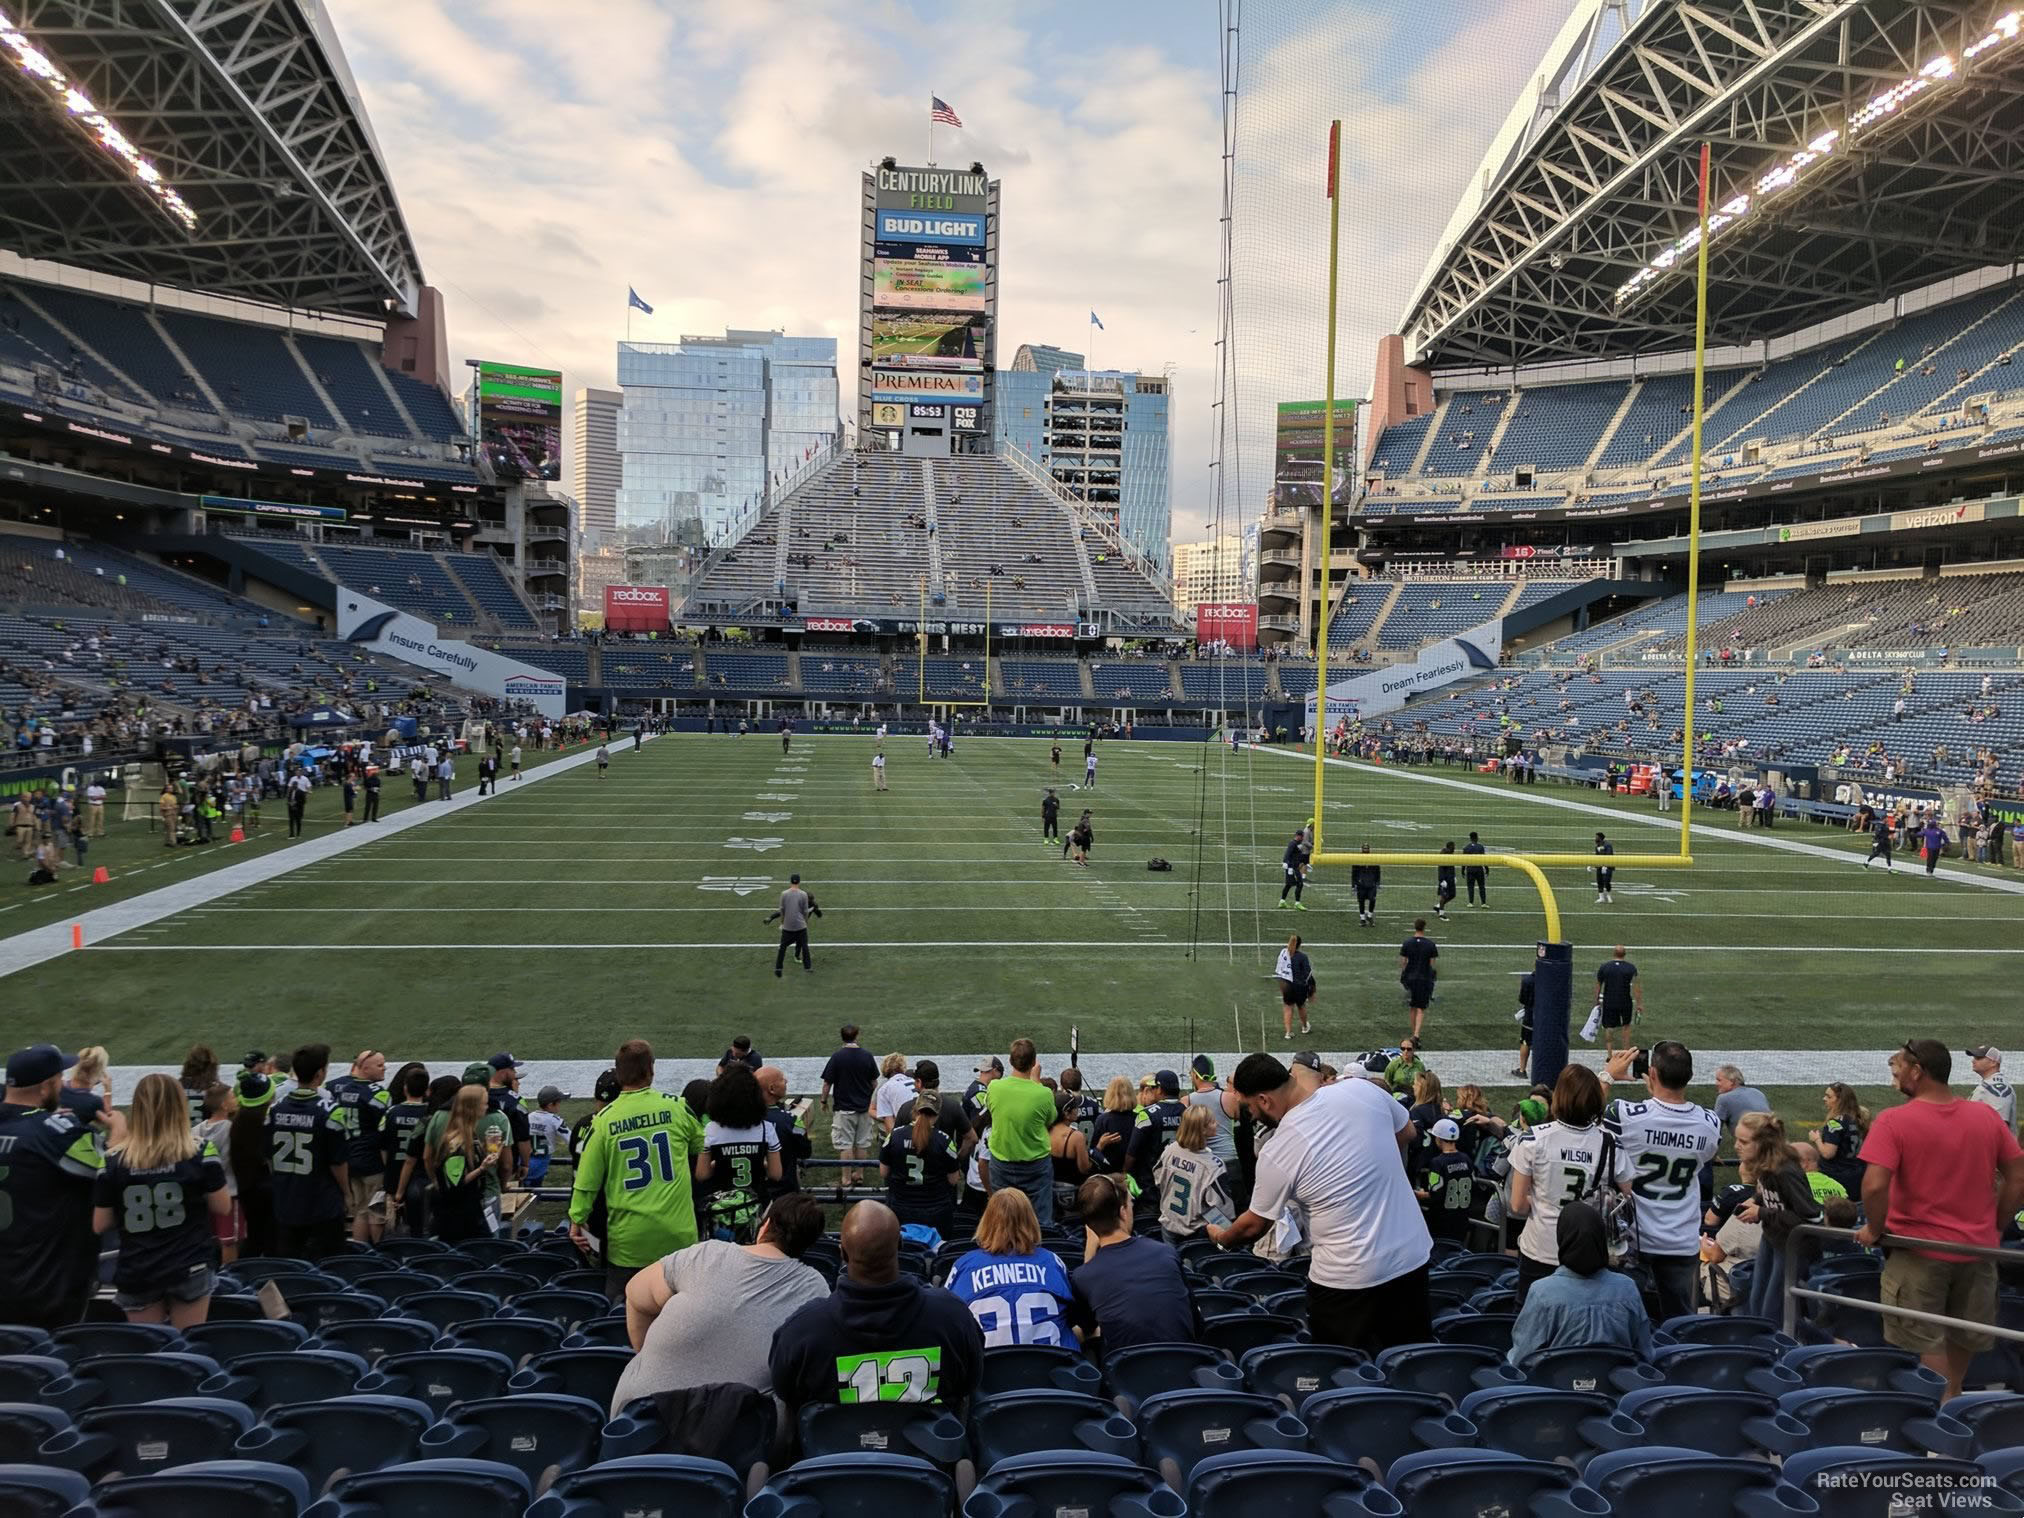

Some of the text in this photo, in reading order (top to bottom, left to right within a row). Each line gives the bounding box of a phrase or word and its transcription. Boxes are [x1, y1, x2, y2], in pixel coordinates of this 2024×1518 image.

[879, 169, 985, 196] CENTURYLINK
[911, 194, 953, 210] FIELD
[885, 218, 977, 237] BUD LIGHT
[874, 373, 955, 390] PREMERA
[954, 407, 977, 419] Q13
[955, 418, 975, 429] FOX
[1906, 510, 1957, 529] verizon
[1514, 547, 1529, 557] 16
[951, 623, 985, 635] NEST
[389, 631, 479, 672] Insure Carefully
[1856, 651, 1882, 659] DELTA
[1382, 660, 1464, 694] Dream Fearlessly
[275, 1112, 315, 1128] SHERMAN
[608, 1110, 673, 1136] CHANCELLOR
[721, 1144, 760, 1157] WILSON
[1644, 1129, 1707, 1151] THOMAS III
[272, 1131, 314, 1176] 25
[618, 1131, 676, 1192] 31
[1171, 1155, 1197, 1174] WILSON
[1560, 1148, 1593, 1164] WILSON
[731, 1157, 753, 1188] 3
[905, 1154, 925, 1186] 3
[1630, 1152, 1698, 1201] 29
[1169, 1174, 1192, 1217] 3
[1443, 1177, 1473, 1209] 88
[1558, 1166, 1587, 1206] 3
[1812, 1188, 1841, 1198] HERMAN
[122, 1181, 187, 1234] 88
[970, 1262, 1048, 1294] KENNEDY
[850, 1356, 930, 1403] 12
